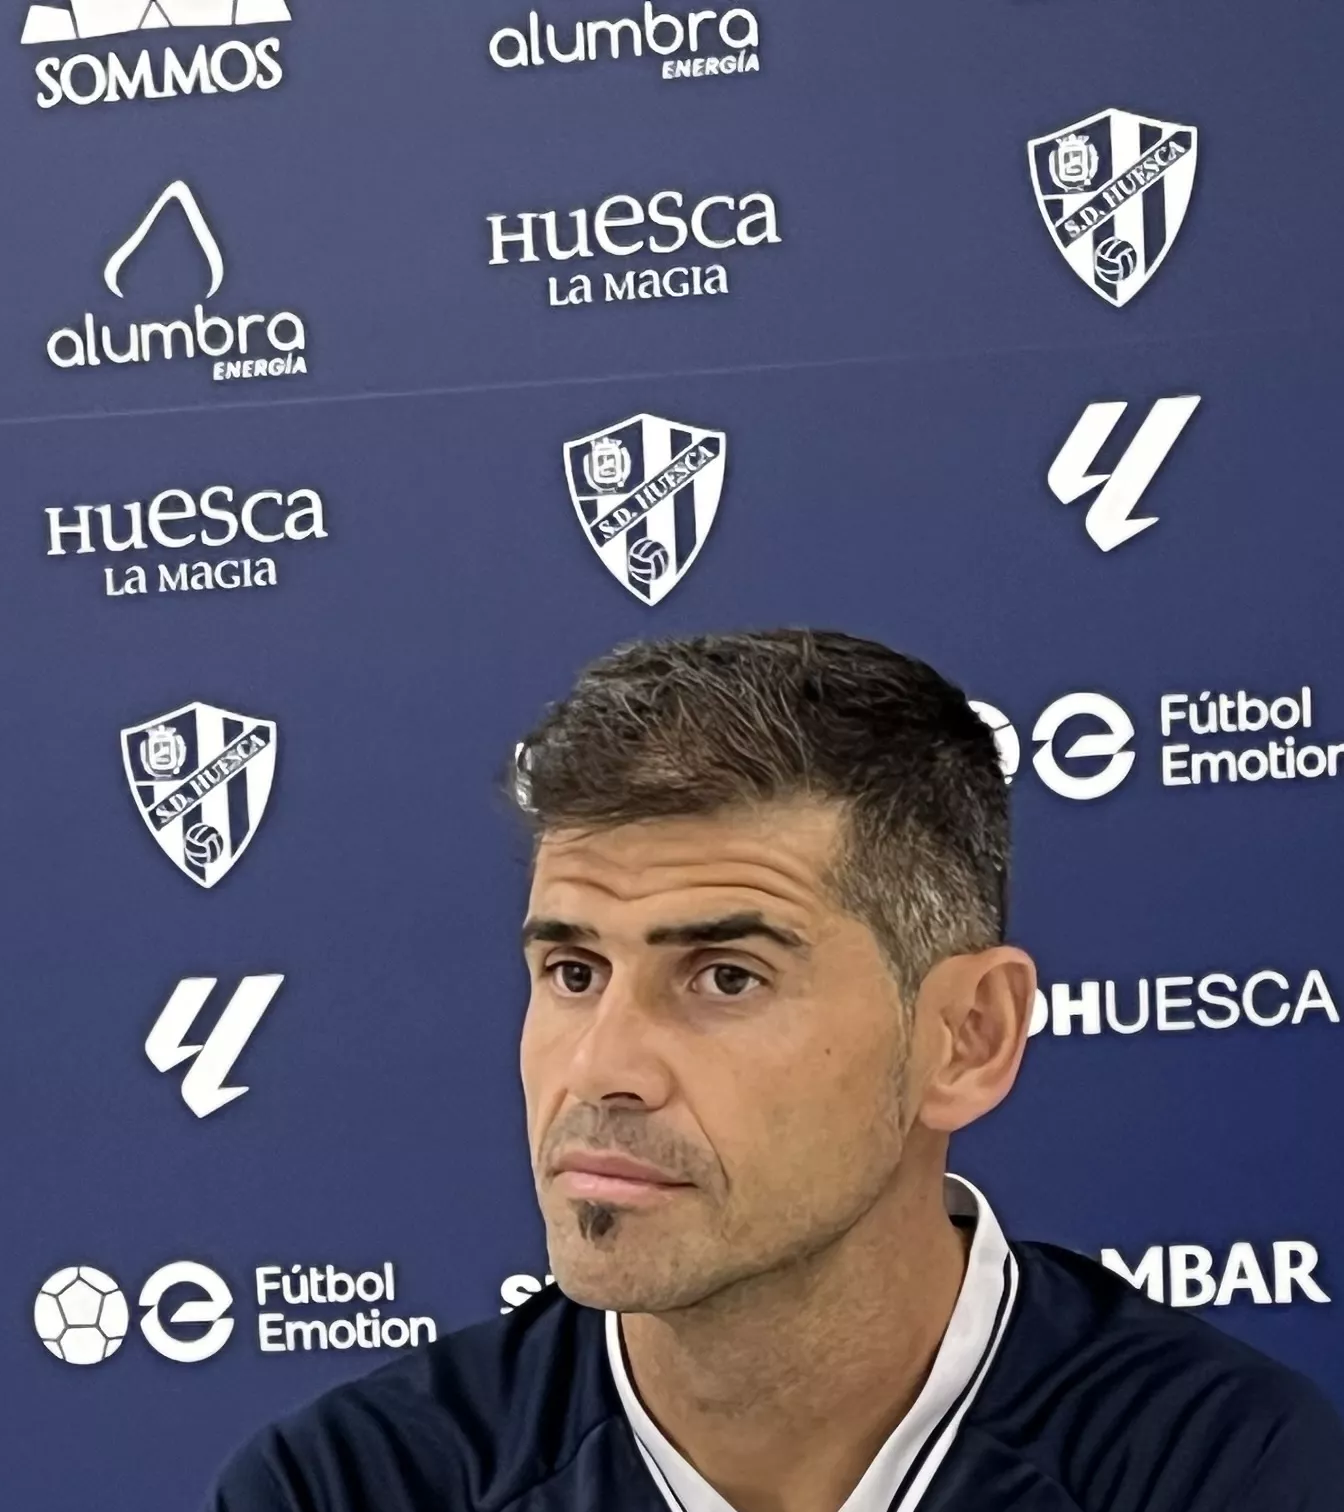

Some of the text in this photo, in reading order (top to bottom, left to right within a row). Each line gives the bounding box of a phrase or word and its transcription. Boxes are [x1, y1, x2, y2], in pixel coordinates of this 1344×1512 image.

[488, 0, 759, 68] alumbra
[34, 36, 283, 109] SOMMOS
[661, 48, 760, 80] ENERGÍA
[46, 303, 305, 368] alumbra
[212, 351, 308, 381] ENERGÍA
[1160, 686, 1312, 737] Fútbol
[255, 1262, 395, 1306] Fútbol
[258, 1308, 437, 1352] Emotion
